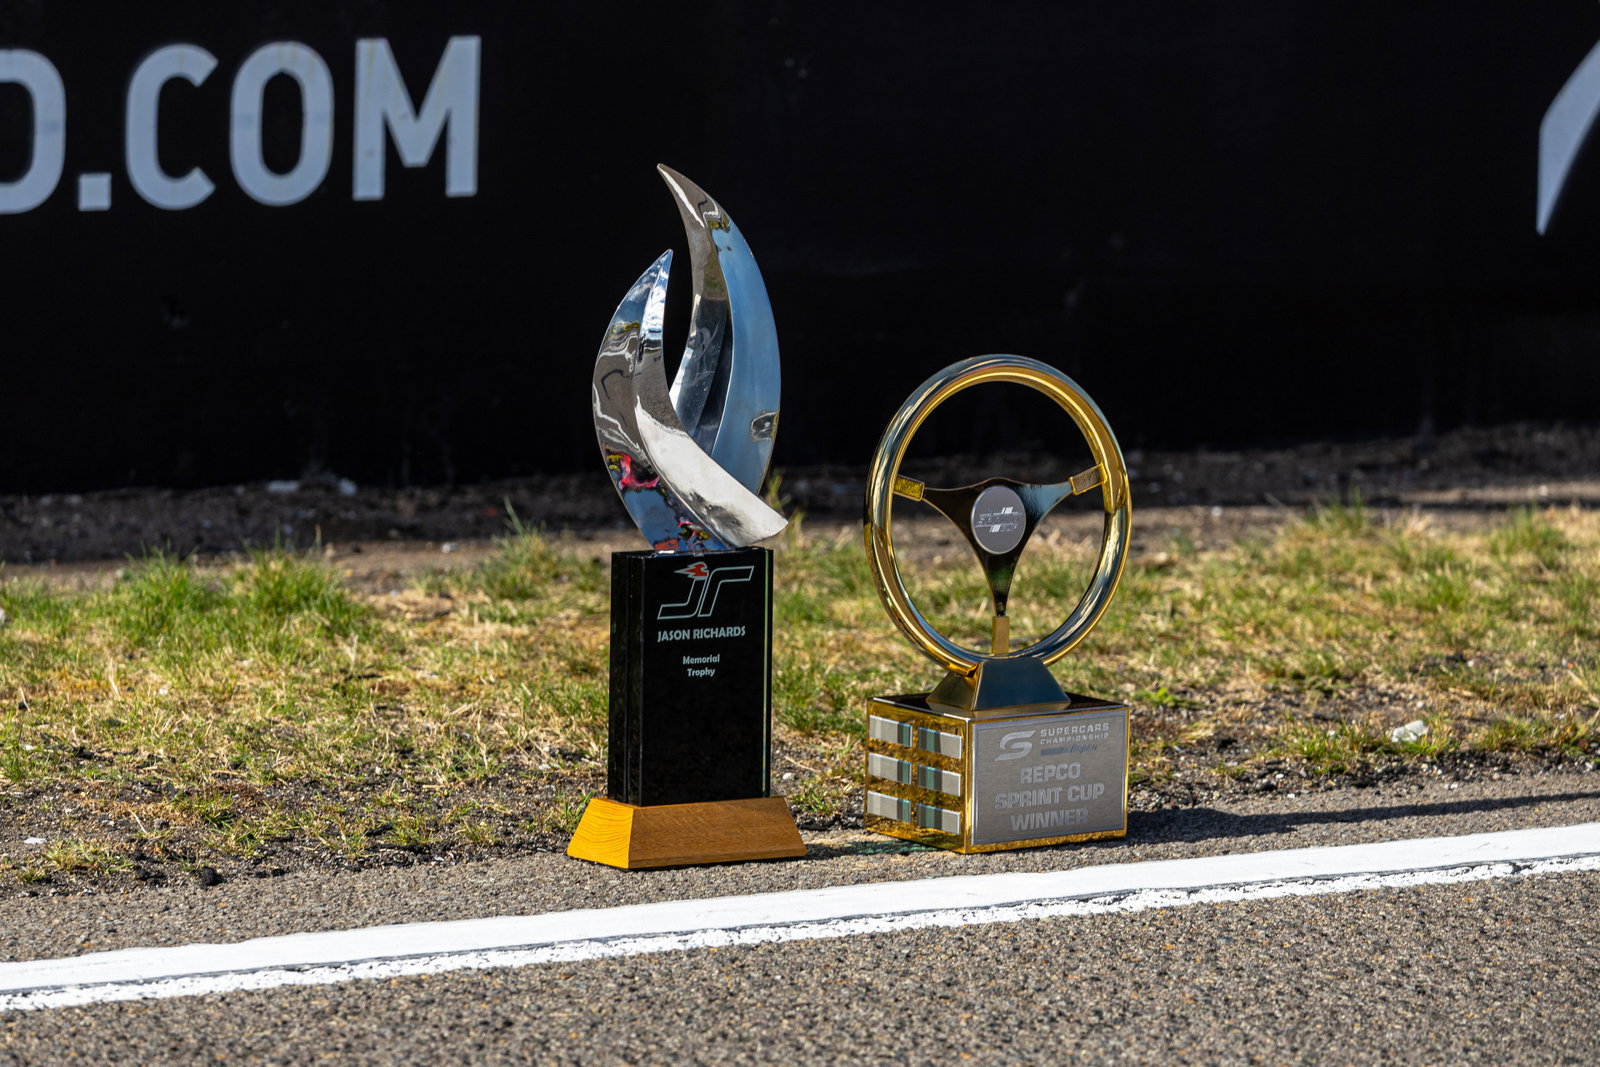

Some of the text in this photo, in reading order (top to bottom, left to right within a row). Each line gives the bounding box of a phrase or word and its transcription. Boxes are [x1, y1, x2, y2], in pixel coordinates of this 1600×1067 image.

[657, 625, 746, 643] JASON RICHARDS
[682, 654, 720, 665] Memorial
[687, 667, 715, 678] Trophy
[1040, 722, 1109, 737] SUPERCARS
[1040, 732, 1109, 745] CHAMPIONSHIP
[1020, 762, 1081, 784] REPCO
[994, 782, 1105, 810] SPRINT CUP
[1010, 807, 1089, 832] WINNER
